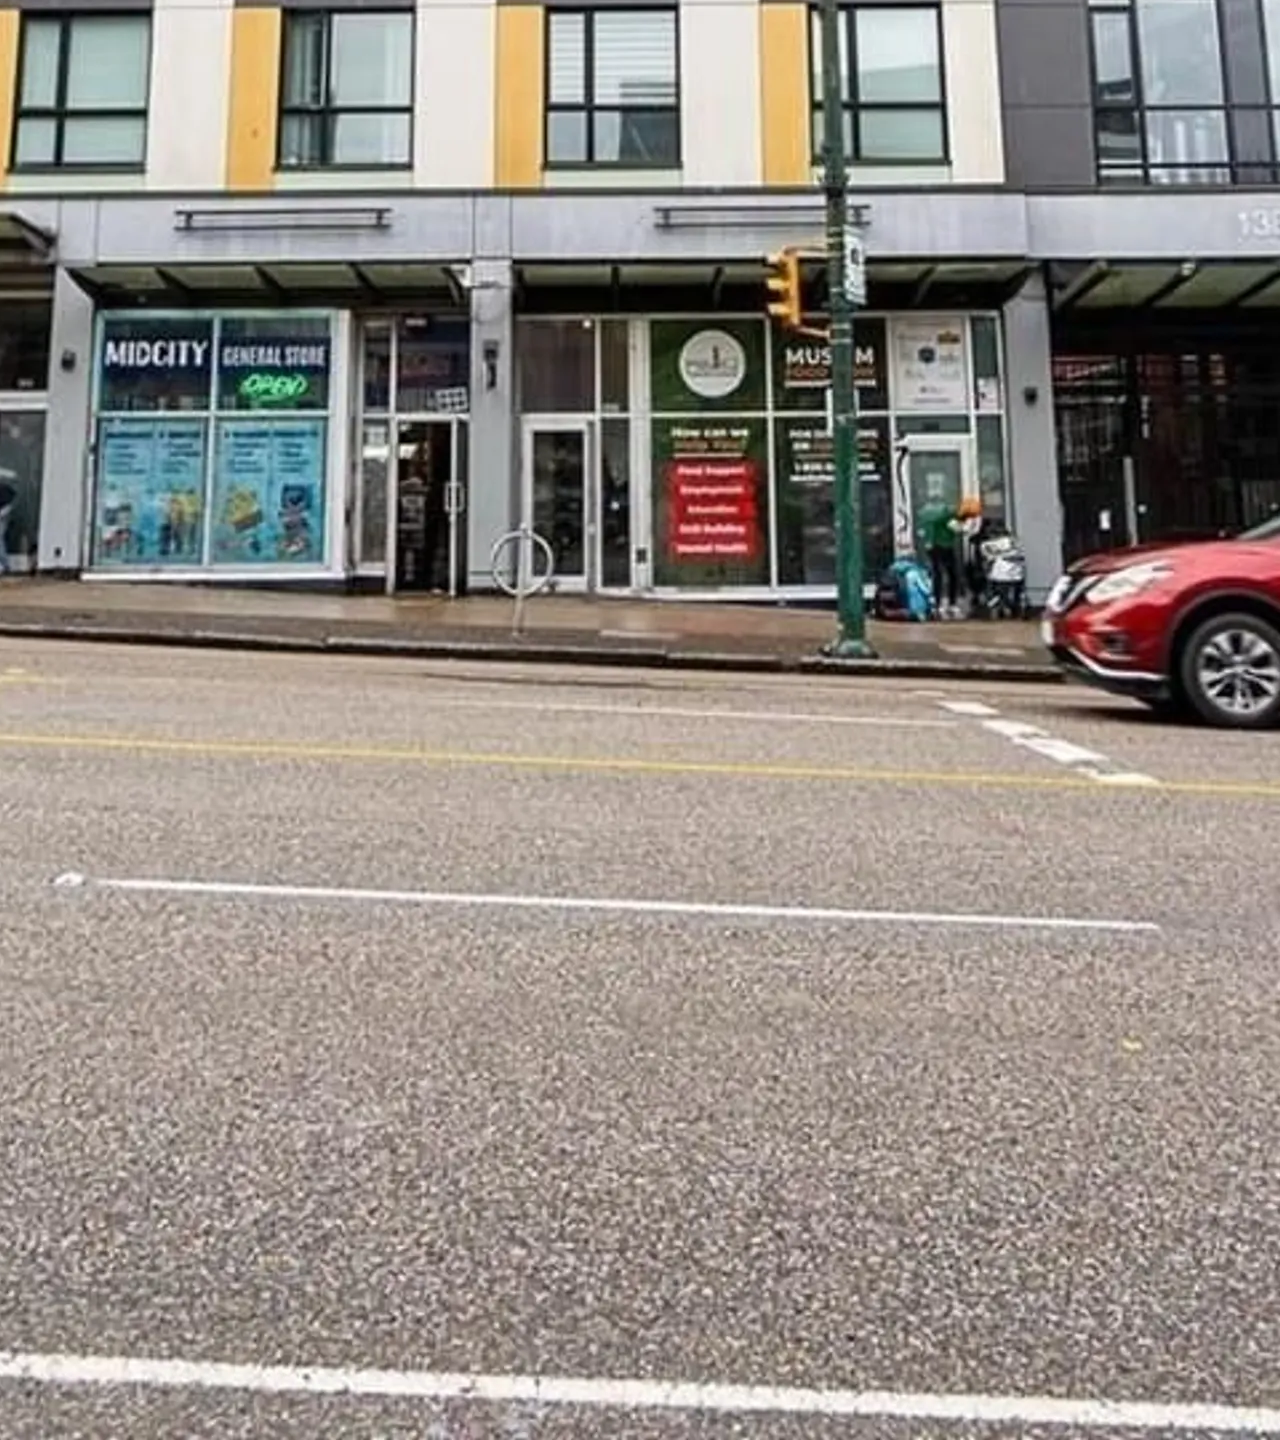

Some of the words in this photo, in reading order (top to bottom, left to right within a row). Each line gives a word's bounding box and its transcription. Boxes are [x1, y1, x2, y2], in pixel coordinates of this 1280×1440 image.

[105, 339, 208, 366] MIDCITY
[222, 345, 281, 366] GENERAL
[285, 345, 325, 366] STORE
[785, 346, 874, 364] MUSM
[241, 372, 308, 397] OPEN
